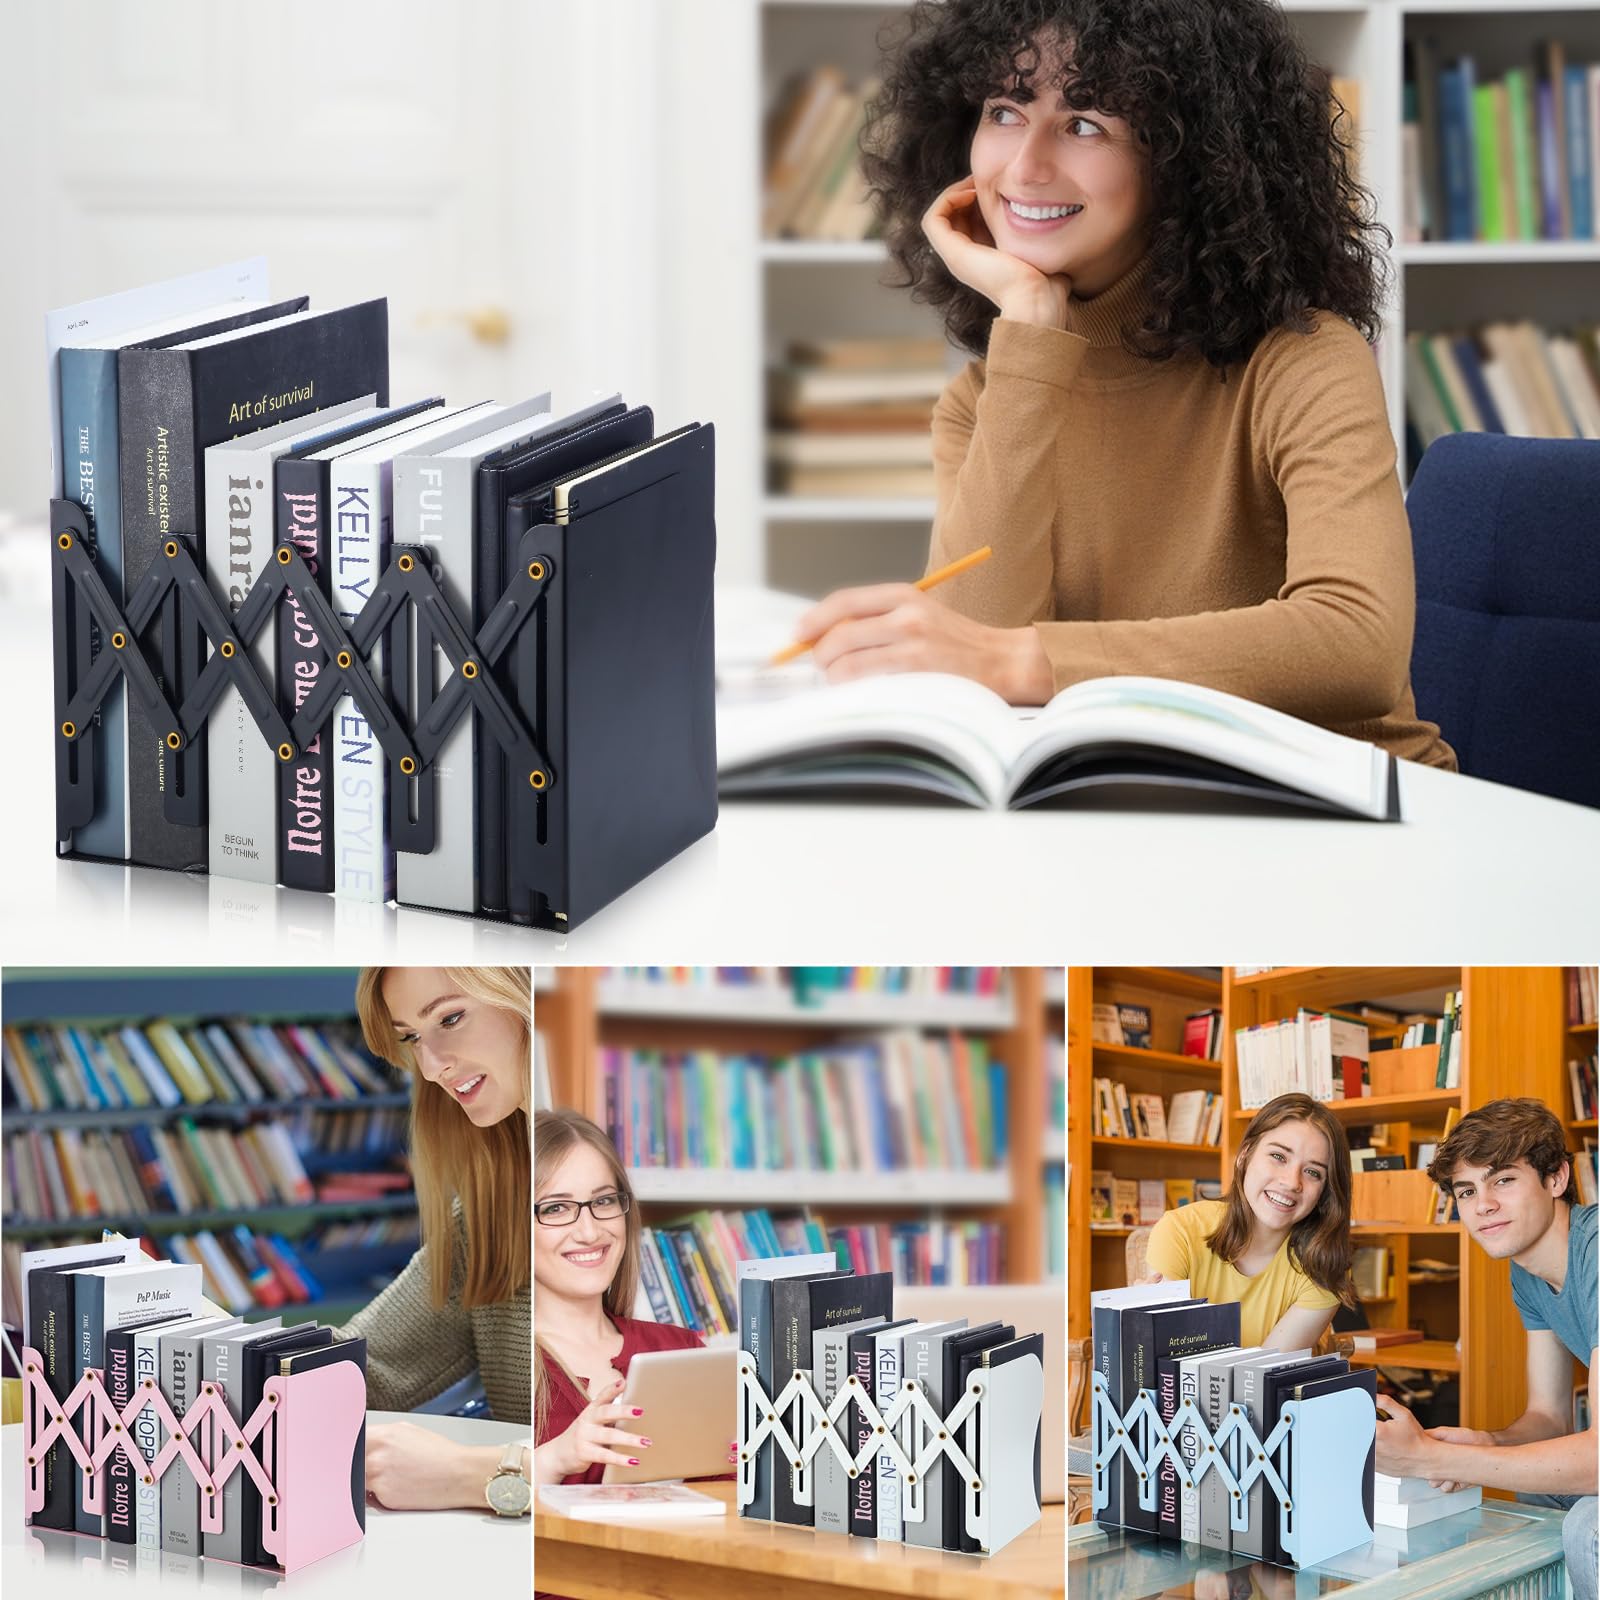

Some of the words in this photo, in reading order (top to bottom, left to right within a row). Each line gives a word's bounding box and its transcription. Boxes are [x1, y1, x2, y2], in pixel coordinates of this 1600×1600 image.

[229, 402, 251, 424] Art
[254, 395, 268, 416] of
[269, 380, 313, 411] survival
[79, 426, 89, 454] THE
[146, 447, 154, 463] Art
[157, 426, 170, 481] Artistic
[147, 465, 154, 477] of
[147, 478, 156, 516] survival
[419, 468, 443, 546] FULL
[337, 486, 371, 601] KELLY
[287, 766, 323, 856] Notre
[221, 845, 233, 856] TO
[234, 847, 260, 861] THINK
[224, 833, 254, 847] BEGUN
[341, 776, 374, 892] STYLE
[151, 1289, 172, 1301] Music
[825, 1309, 836, 1320] Art
[836, 1308, 842, 1316] of
[48, 1310, 56, 1338] Artistic
[1168, 1336, 1180, 1347] Art
[1180, 1335, 1187, 1344] of
[1187, 1332, 1208, 1344] survival
[82, 1331, 92, 1364] BEST
[879, 1348, 896, 1402] KELLY
[111, 1483, 129, 1527] Notre
[139, 1487, 156, 1545] STYLE
[854, 1479, 873, 1521] Notre
[1160, 1486, 1175, 1524] Notre
